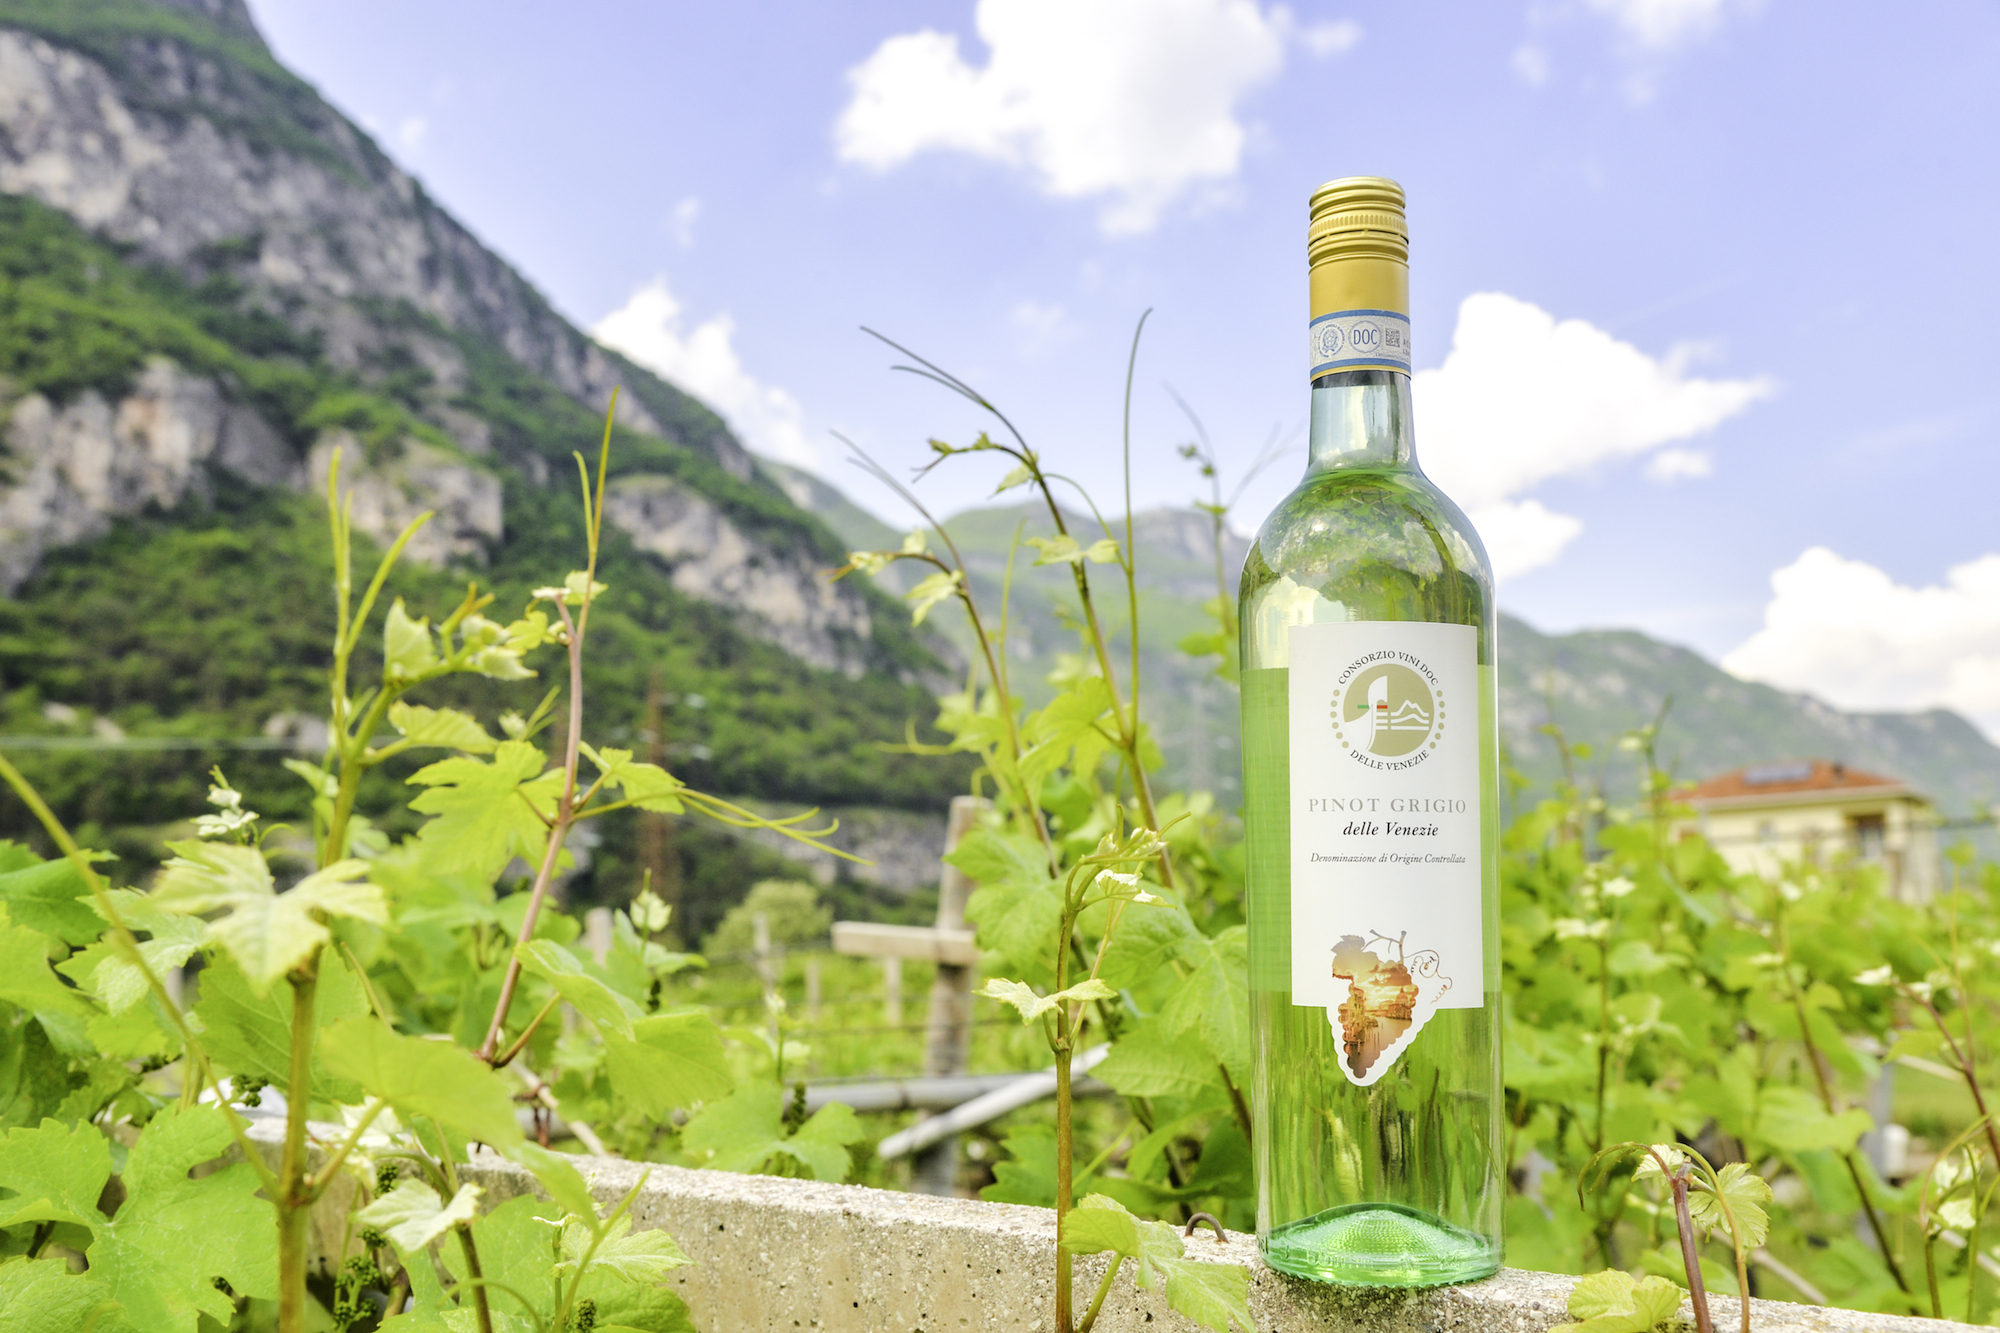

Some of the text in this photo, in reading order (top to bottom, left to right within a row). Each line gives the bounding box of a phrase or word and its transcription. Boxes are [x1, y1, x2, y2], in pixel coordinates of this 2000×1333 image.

[1353, 328, 1378, 345] DOC
[1338, 650, 1439, 686] CONSORZIO VINI DOC
[1350, 749, 1429, 771] DELLE VENEZIE
[1308, 798, 1466, 813] PINOT GRIGIO
[1342, 821, 1439, 837] delle Venezie
[1310, 852, 1466, 865] Denominazione di Origine Controllata
